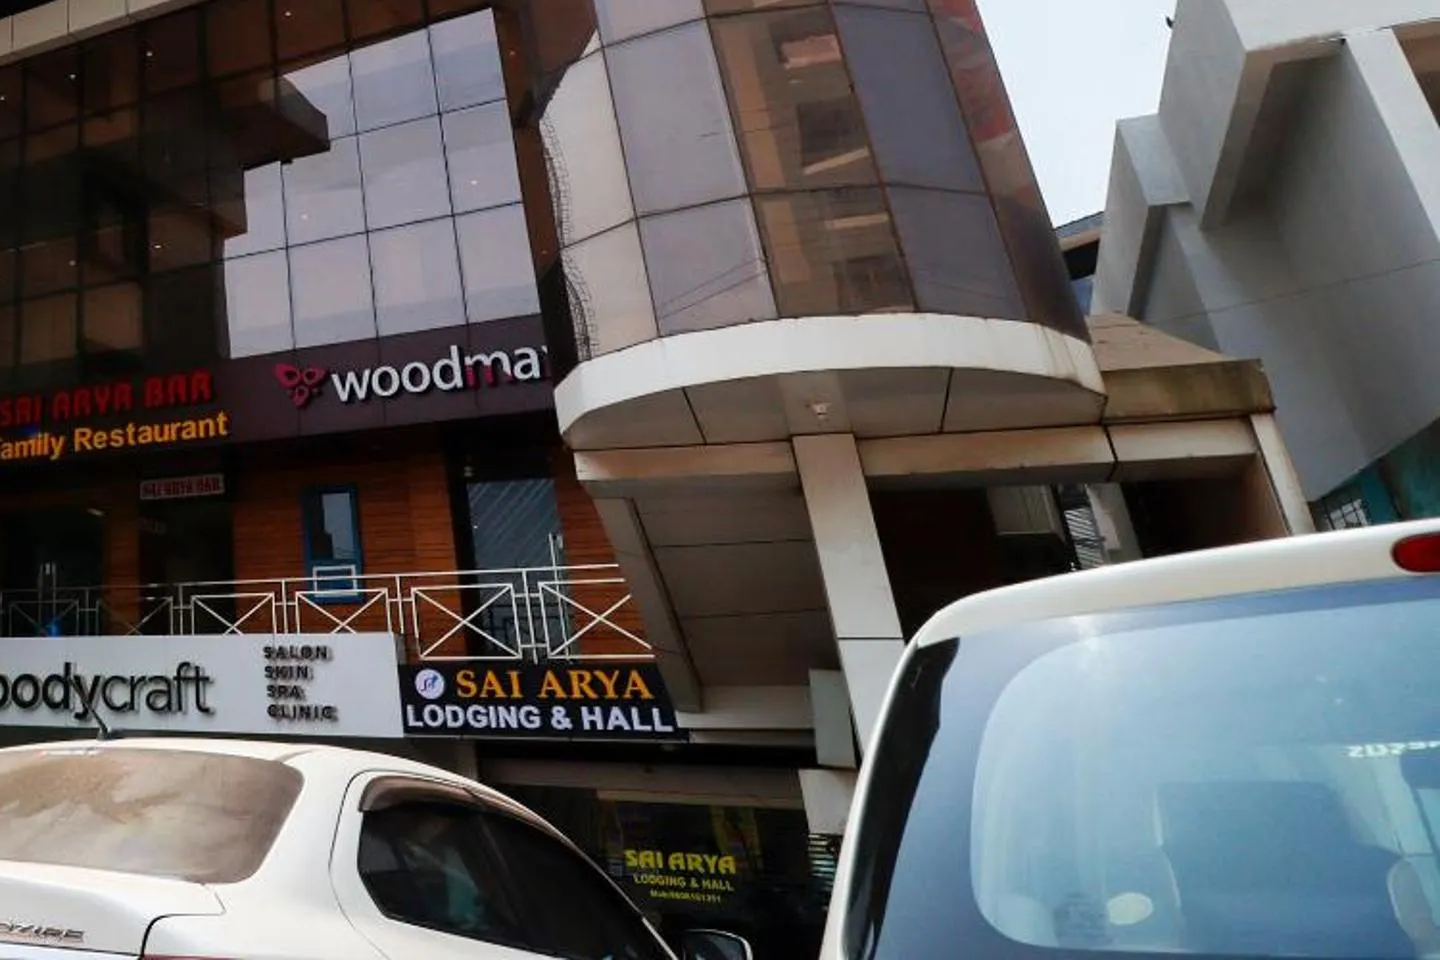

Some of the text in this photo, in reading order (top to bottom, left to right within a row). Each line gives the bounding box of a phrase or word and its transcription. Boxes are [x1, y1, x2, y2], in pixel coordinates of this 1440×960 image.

[330, 344, 548, 404] woodma
[50, 381, 134, 420] ARYA
[142, 367, 214, 409] BAR
[73, 409, 230, 452] Restaurant
[263, 645, 329, 660] SALON
[264, 665, 310, 680] SKIN
[455, 668, 524, 699] SAI
[537, 668, 656, 700] ARYA
[266, 685, 302, 700] SPA
[266, 704, 336, 721] CLINIC
[406, 703, 675, 732] LODGING & HALL
[624, 849, 737, 875] SAI ARYA
[633, 873, 687, 889] LODGING
[701, 878, 735, 892] HALL
